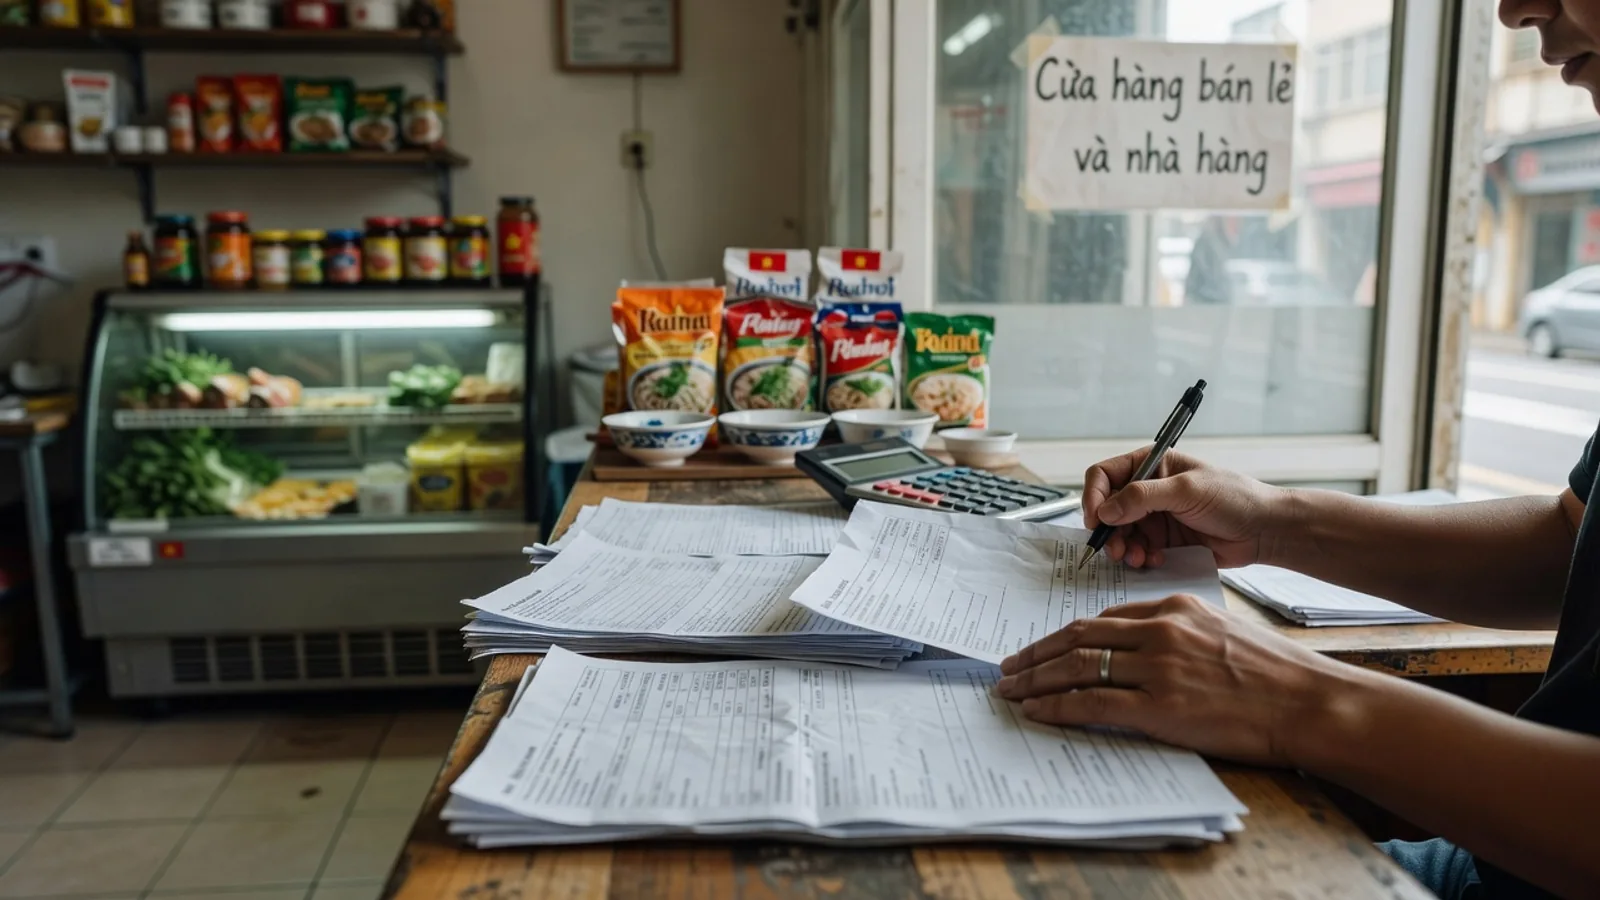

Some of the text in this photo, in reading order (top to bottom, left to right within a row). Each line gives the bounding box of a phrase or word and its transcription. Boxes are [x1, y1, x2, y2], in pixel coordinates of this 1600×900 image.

[1112, 56, 1184, 122] hàng
[1198, 58, 1254, 103] bán
[1266, 60, 1293, 104] lẻ
[1073, 130, 1268, 196] và nhà hàng
